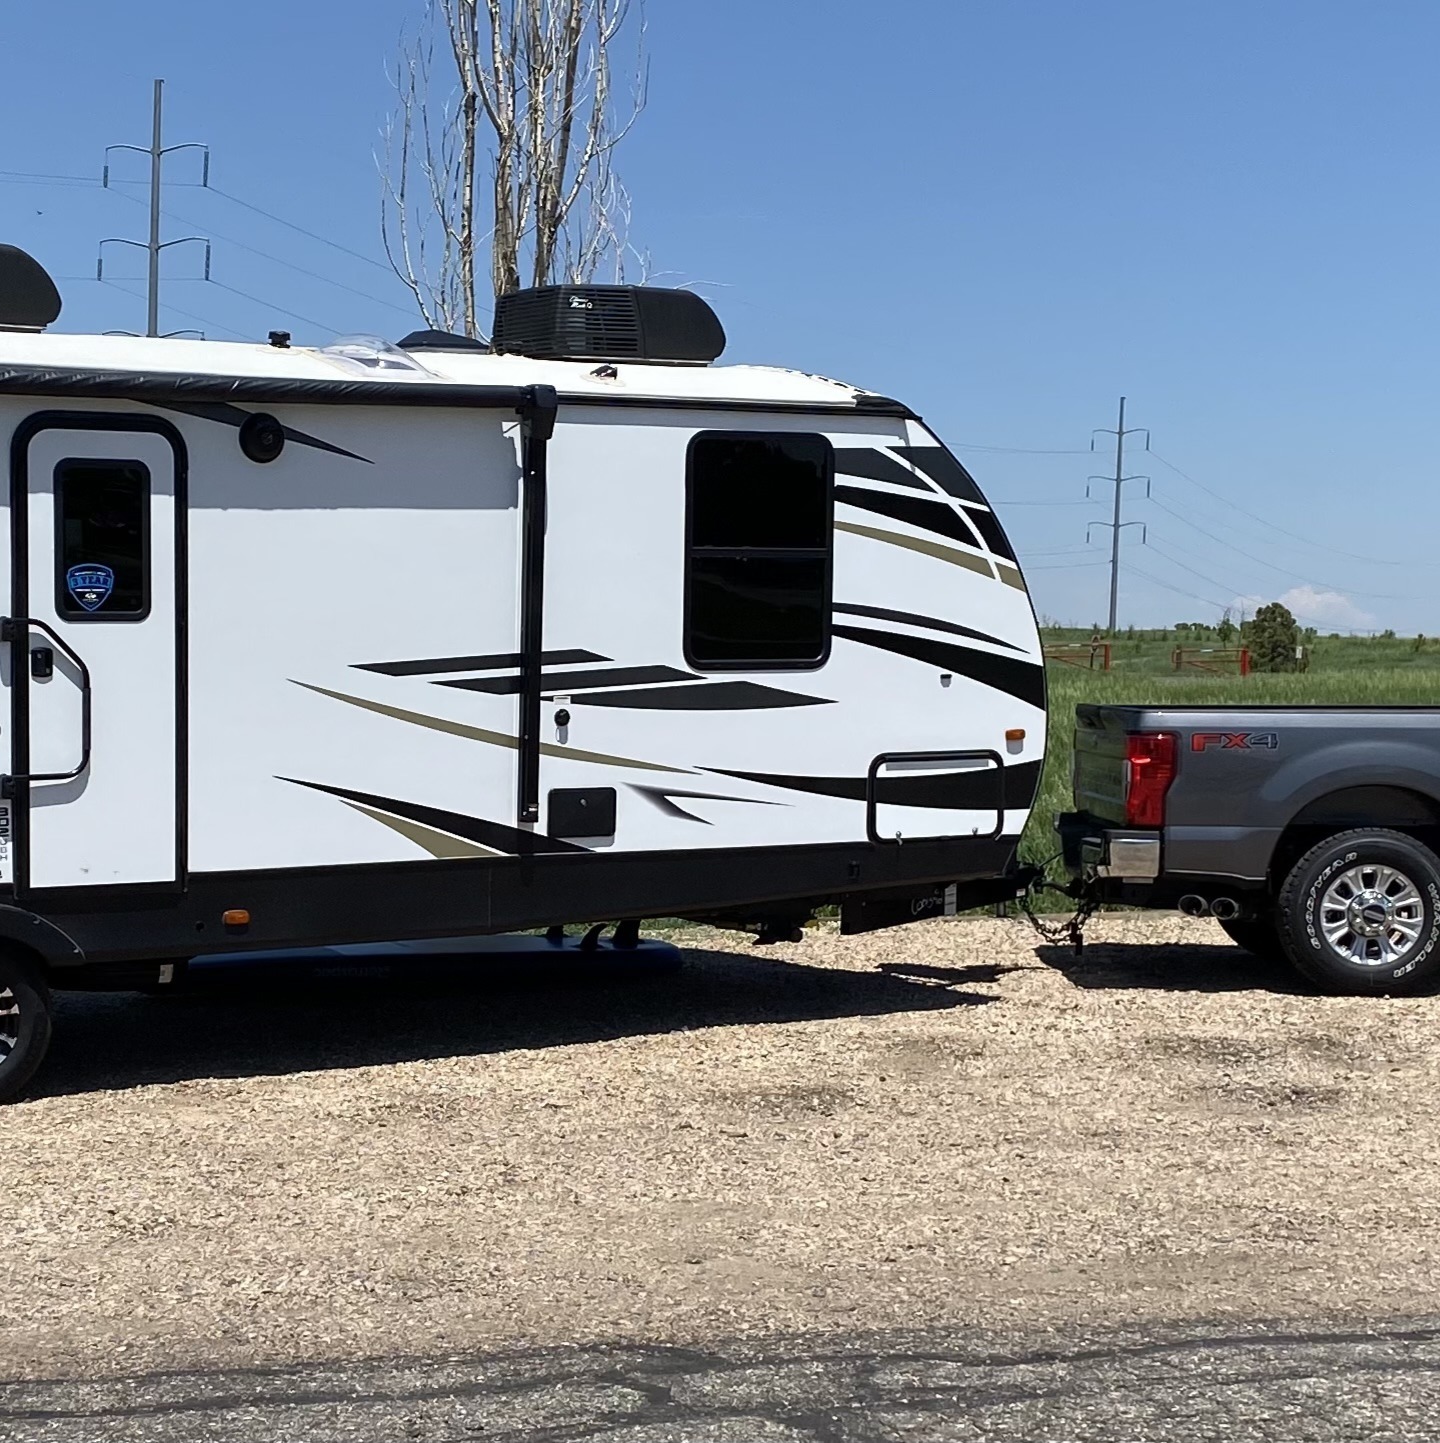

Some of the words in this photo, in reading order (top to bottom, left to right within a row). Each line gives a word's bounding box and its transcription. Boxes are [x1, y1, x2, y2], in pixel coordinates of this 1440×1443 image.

[80, 576, 109, 586] YEAR
[1191, 731, 1279, 752] FX4
[1305, 851, 1358, 950] GOODYEAR
[1393, 882, 1440, 978] WRANGLER
